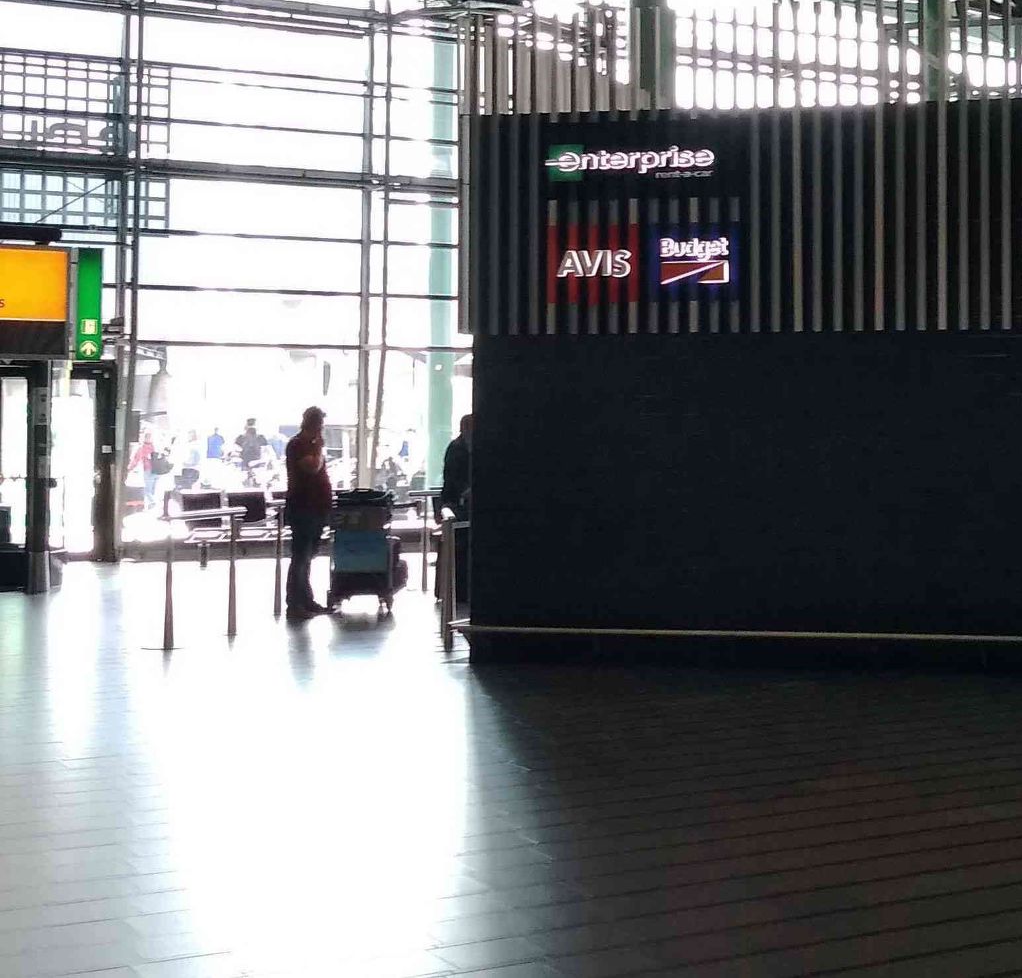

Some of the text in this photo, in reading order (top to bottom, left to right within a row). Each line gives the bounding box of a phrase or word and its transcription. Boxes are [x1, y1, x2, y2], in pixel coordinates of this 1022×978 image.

[545, 145, 715, 173] enterprise
[660, 237, 729, 261] Budget
[557, 249, 632, 278] AVIS
